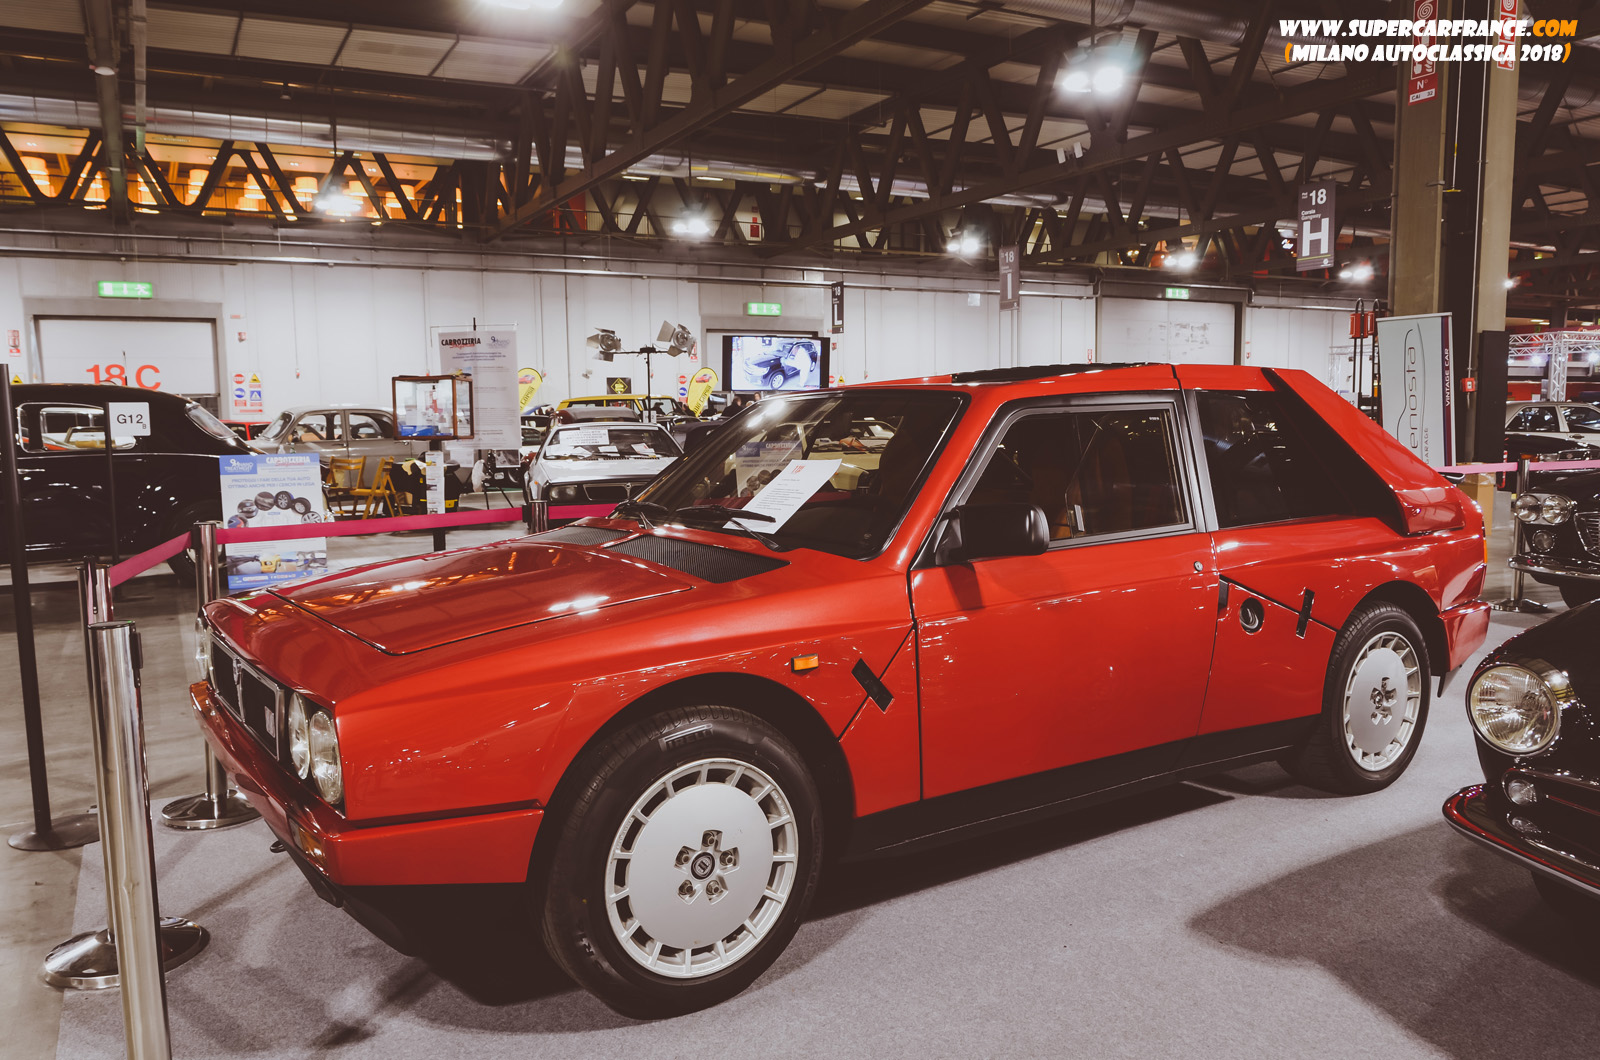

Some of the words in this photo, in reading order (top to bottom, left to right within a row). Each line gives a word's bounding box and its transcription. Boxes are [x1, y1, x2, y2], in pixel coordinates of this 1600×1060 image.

[1309, 188, 1327, 206] 18
[1302, 217, 1330, 257] H
[1004, 250, 1015, 263] 18
[834, 304, 843, 326] L
[86, 363, 126, 387] 18
[135, 364, 161, 391] C
[1406, 346, 1418, 449] enosta
[116, 413, 143, 425] G12
